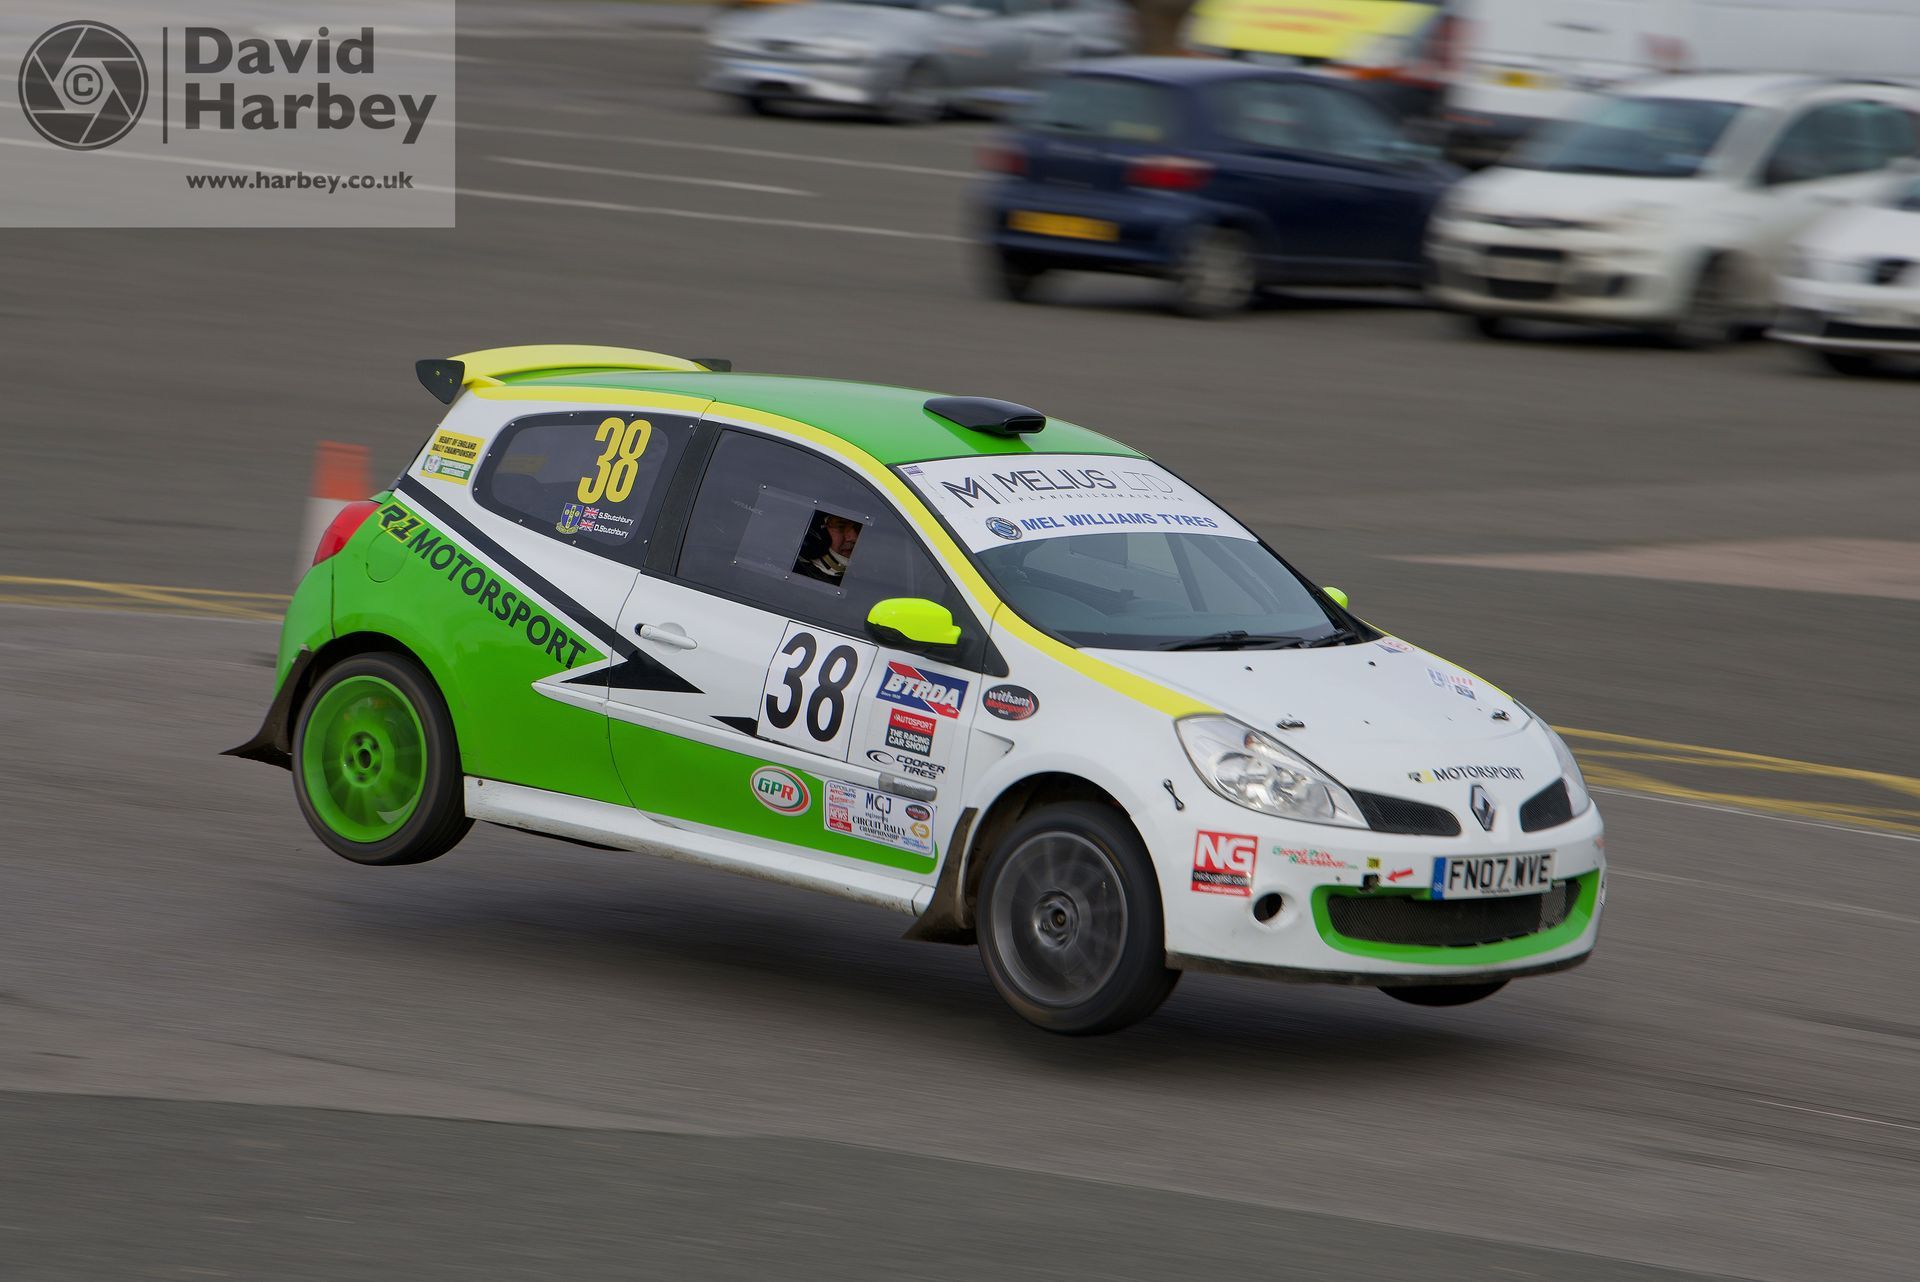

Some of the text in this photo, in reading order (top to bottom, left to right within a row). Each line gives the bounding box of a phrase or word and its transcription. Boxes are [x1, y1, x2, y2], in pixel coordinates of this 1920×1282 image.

[577, 417, 652, 504] 38
[992, 470, 1118, 493] MELIUS
[1111, 471, 1173, 494] LTD
[1020, 513, 1220, 531] MEL WILLIAMS TYRES
[406, 527, 586, 669] MOTORSPORT
[765, 632, 859, 742] 38
[884, 672, 960, 709] BTRDA
[888, 736, 930, 753] CAR SHOW
[889, 728, 904, 738] THE
[903, 731, 930, 746] RACING
[896, 754, 946, 774] COOPER
[902, 764, 937, 780] TIRES
[1432, 765, 1526, 782] MOTORSPORT
[757, 777, 794, 801] GPR
[852, 816, 884, 830] CIRCUIT
[1196, 833, 1256, 873] NG
[1448, 859, 1510, 891] FN07
